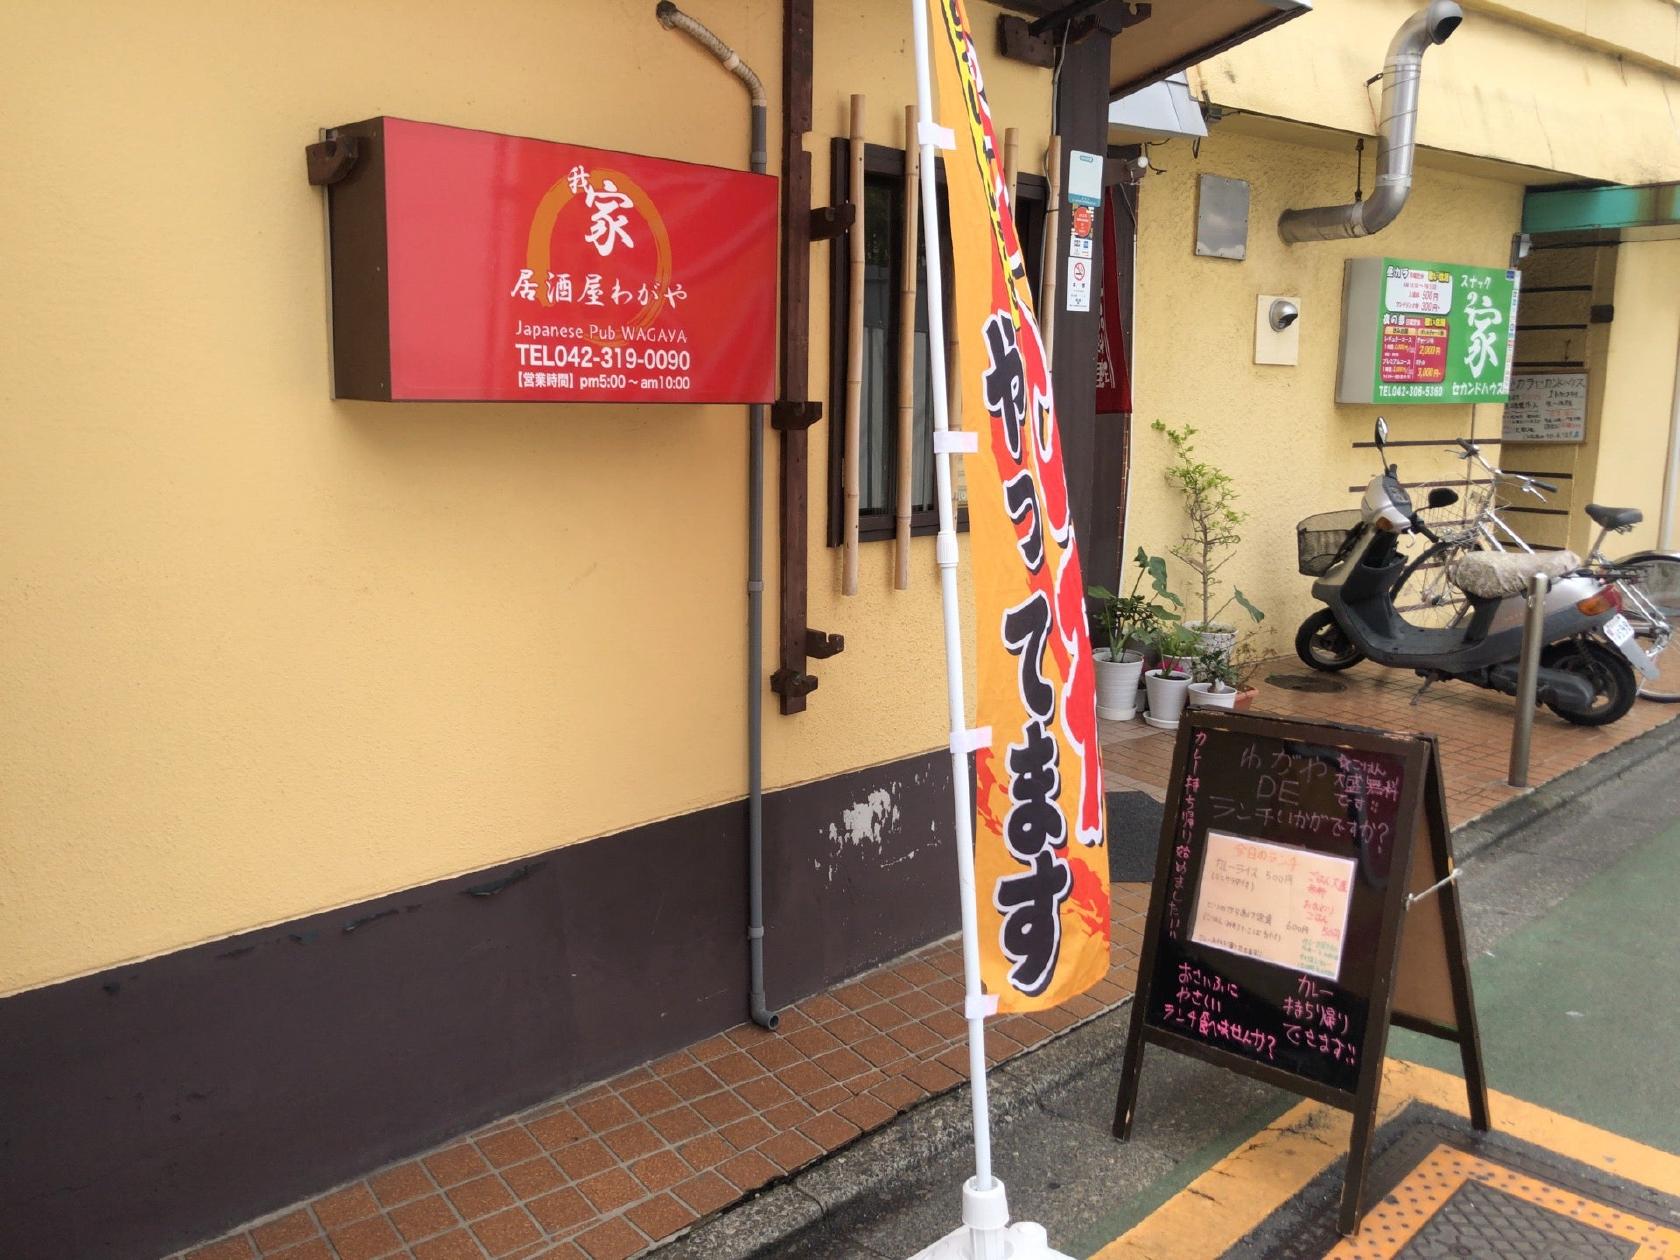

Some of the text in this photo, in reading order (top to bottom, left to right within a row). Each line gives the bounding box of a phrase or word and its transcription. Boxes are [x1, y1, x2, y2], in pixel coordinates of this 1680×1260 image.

[510, 268, 688, 309] 居酒屋わがや
[1461, 275, 1492, 289] スナック
[515, 320, 688, 343] Japanese Pub WAGAYA
[515, 343, 690, 370] TEL042-319-0090
[982, 309, 1073, 996] やってます
[1240, 744, 1328, 783] わがや
[1257, 774, 1299, 805] DE
[1179, 962, 1239, 998] おさいふに
[1298, 974, 1334, 998] カレー
